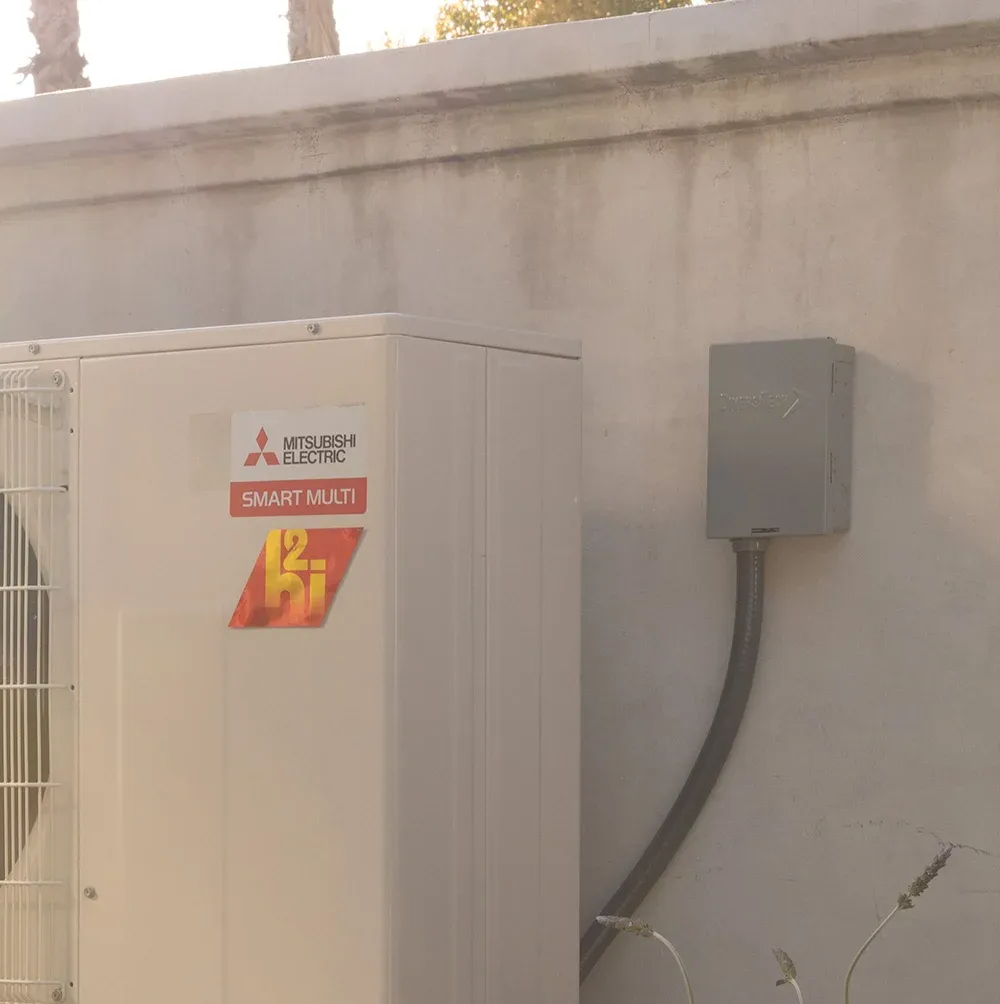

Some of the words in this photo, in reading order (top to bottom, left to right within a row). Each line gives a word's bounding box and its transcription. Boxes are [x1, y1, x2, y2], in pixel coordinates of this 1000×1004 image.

[283, 434, 356, 450] MITSUBISHI
[283, 449, 346, 465] ELECTRIC
[242, 490, 303, 507] SMART
[306, 488, 356, 505] MULTI
